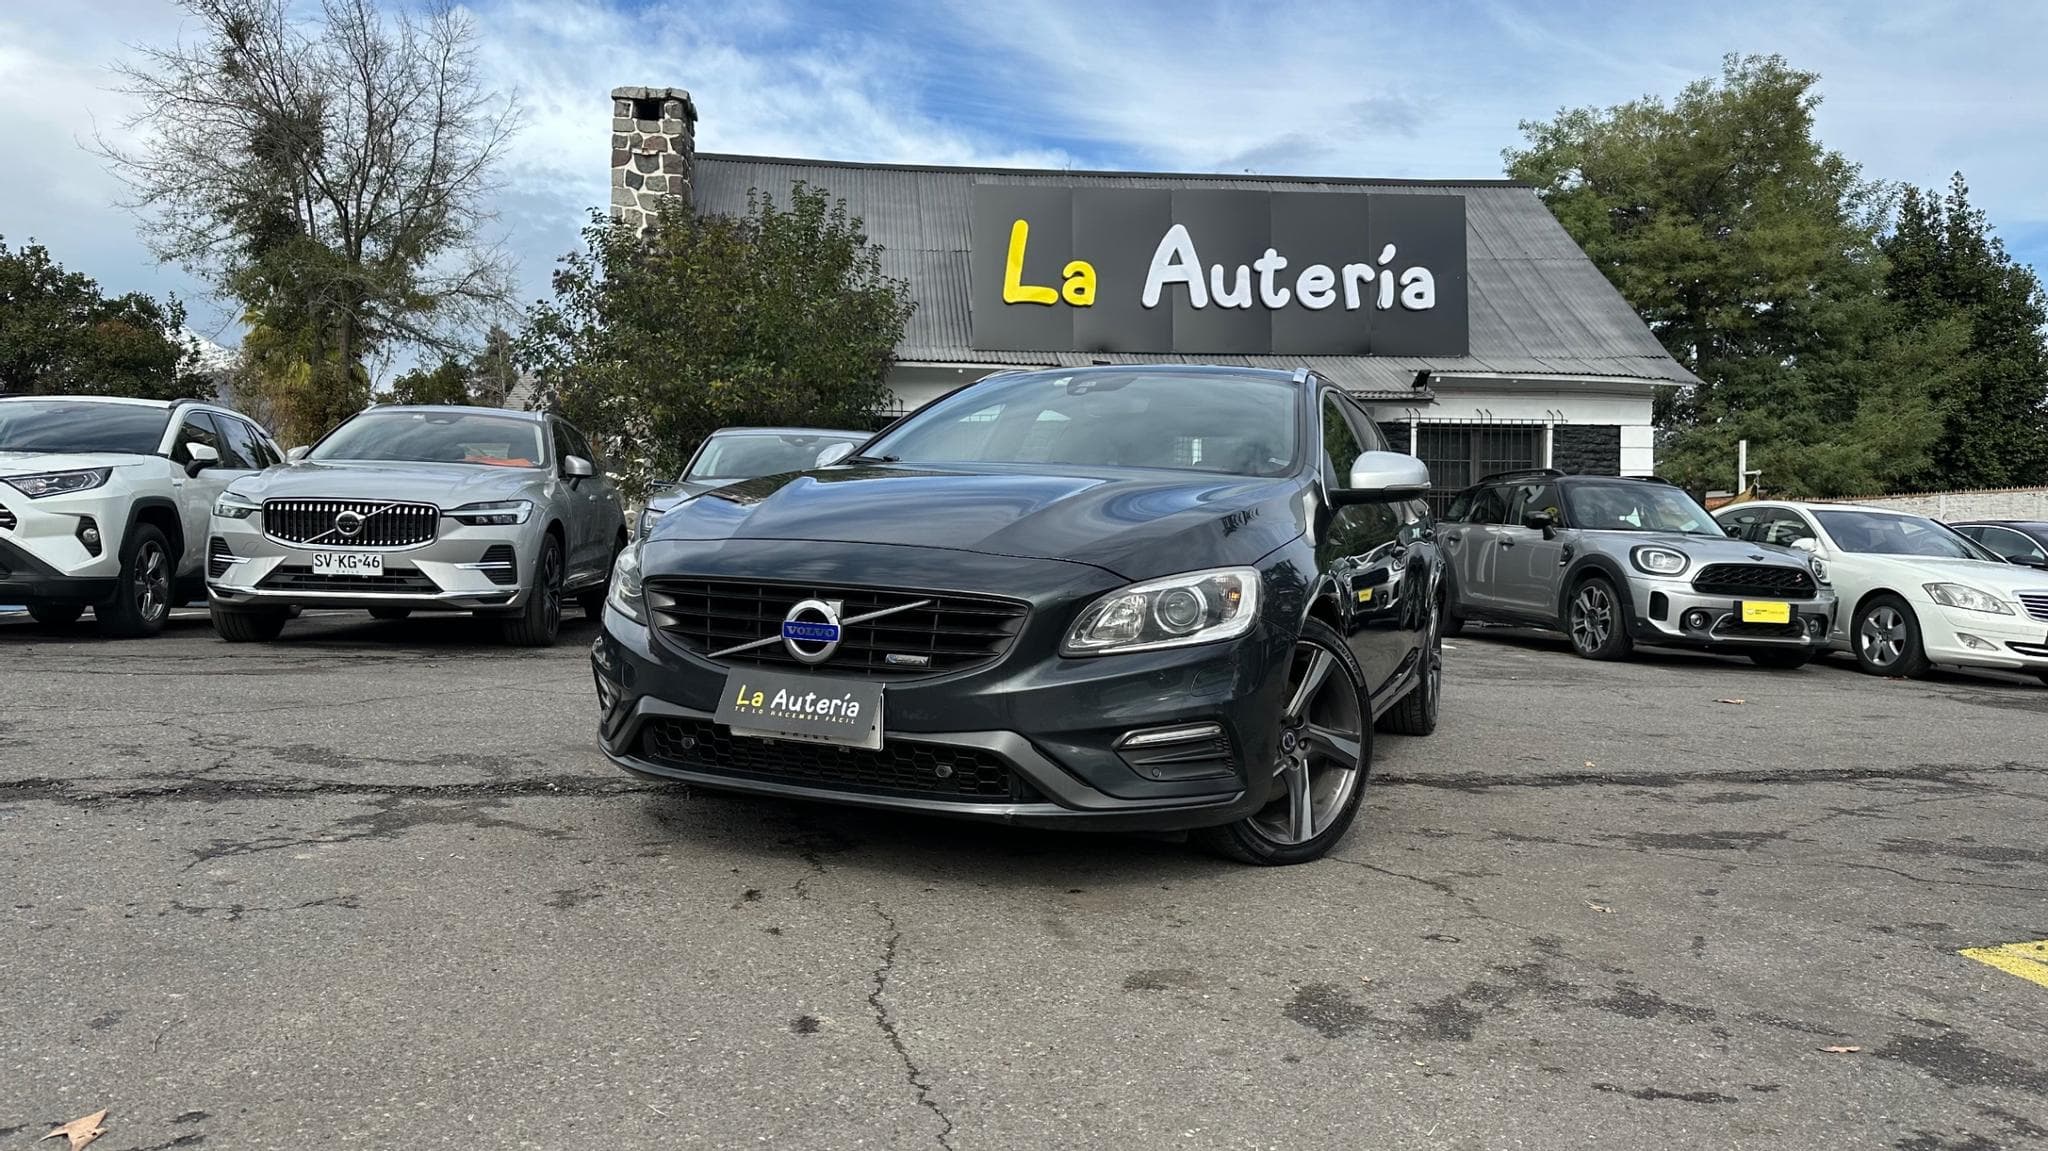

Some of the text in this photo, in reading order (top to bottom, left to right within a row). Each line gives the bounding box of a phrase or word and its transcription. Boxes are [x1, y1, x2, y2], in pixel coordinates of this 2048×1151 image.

[1002, 219, 1436, 310] La Autería
[786, 625, 835, 637] VOLVO
[737, 685, 860, 717] La Autería
